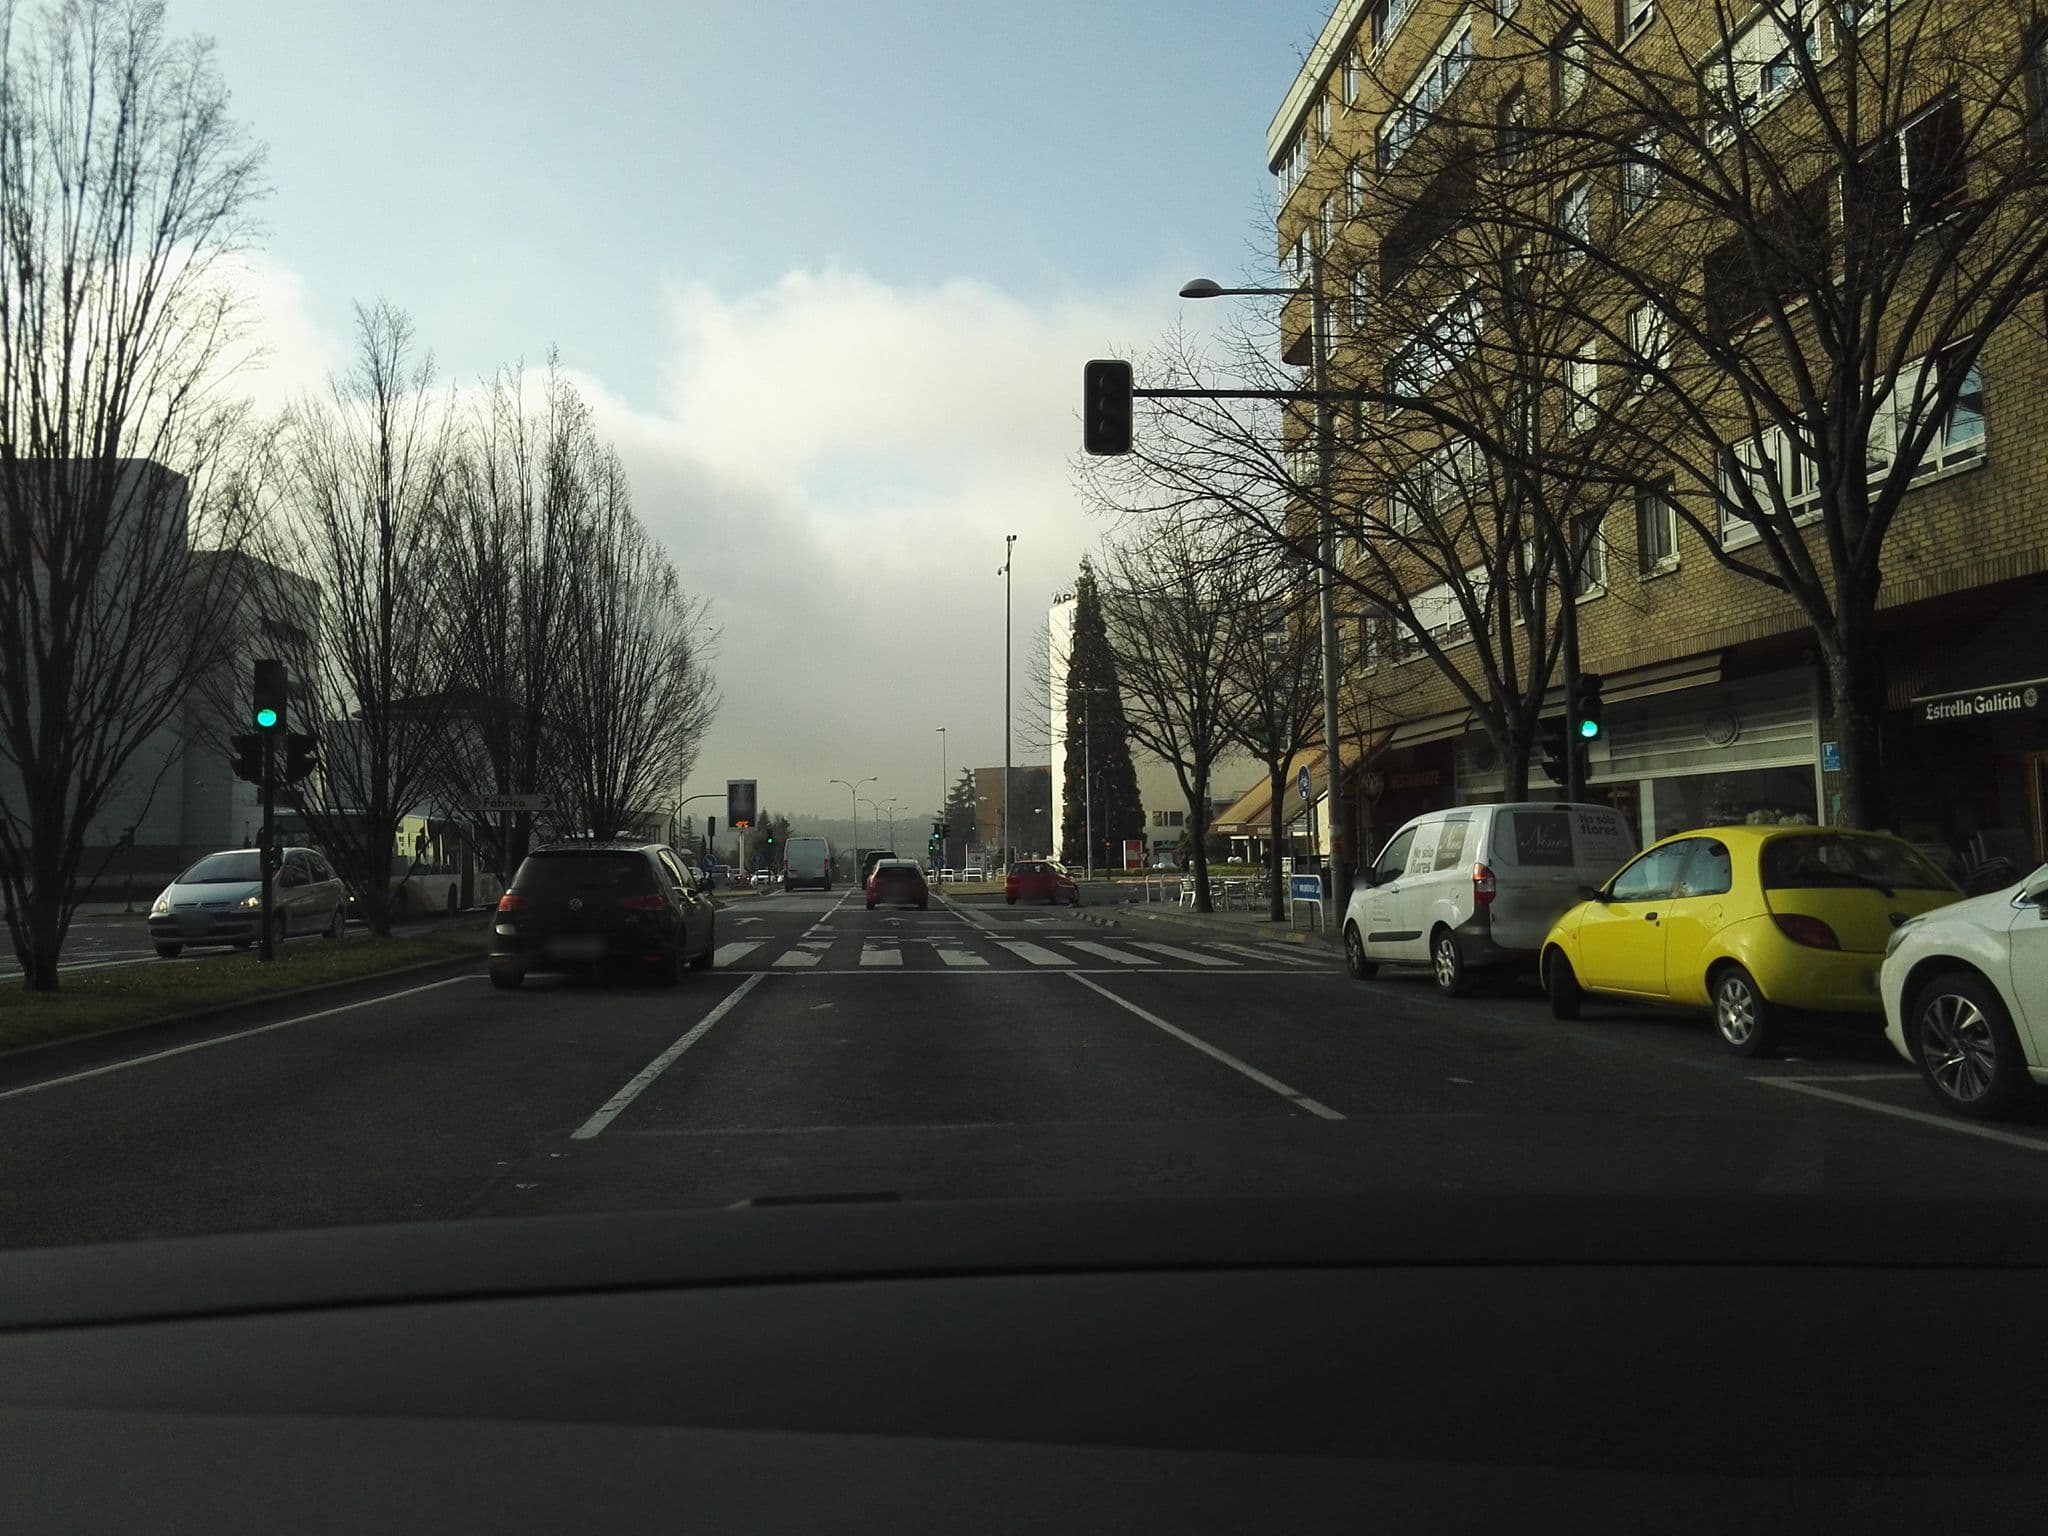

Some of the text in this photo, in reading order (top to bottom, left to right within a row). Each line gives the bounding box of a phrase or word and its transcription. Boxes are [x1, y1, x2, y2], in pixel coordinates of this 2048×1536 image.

[1926, 691, 2021, 720] Estrella Galicia
[1583, 824, 1619, 836] flores
